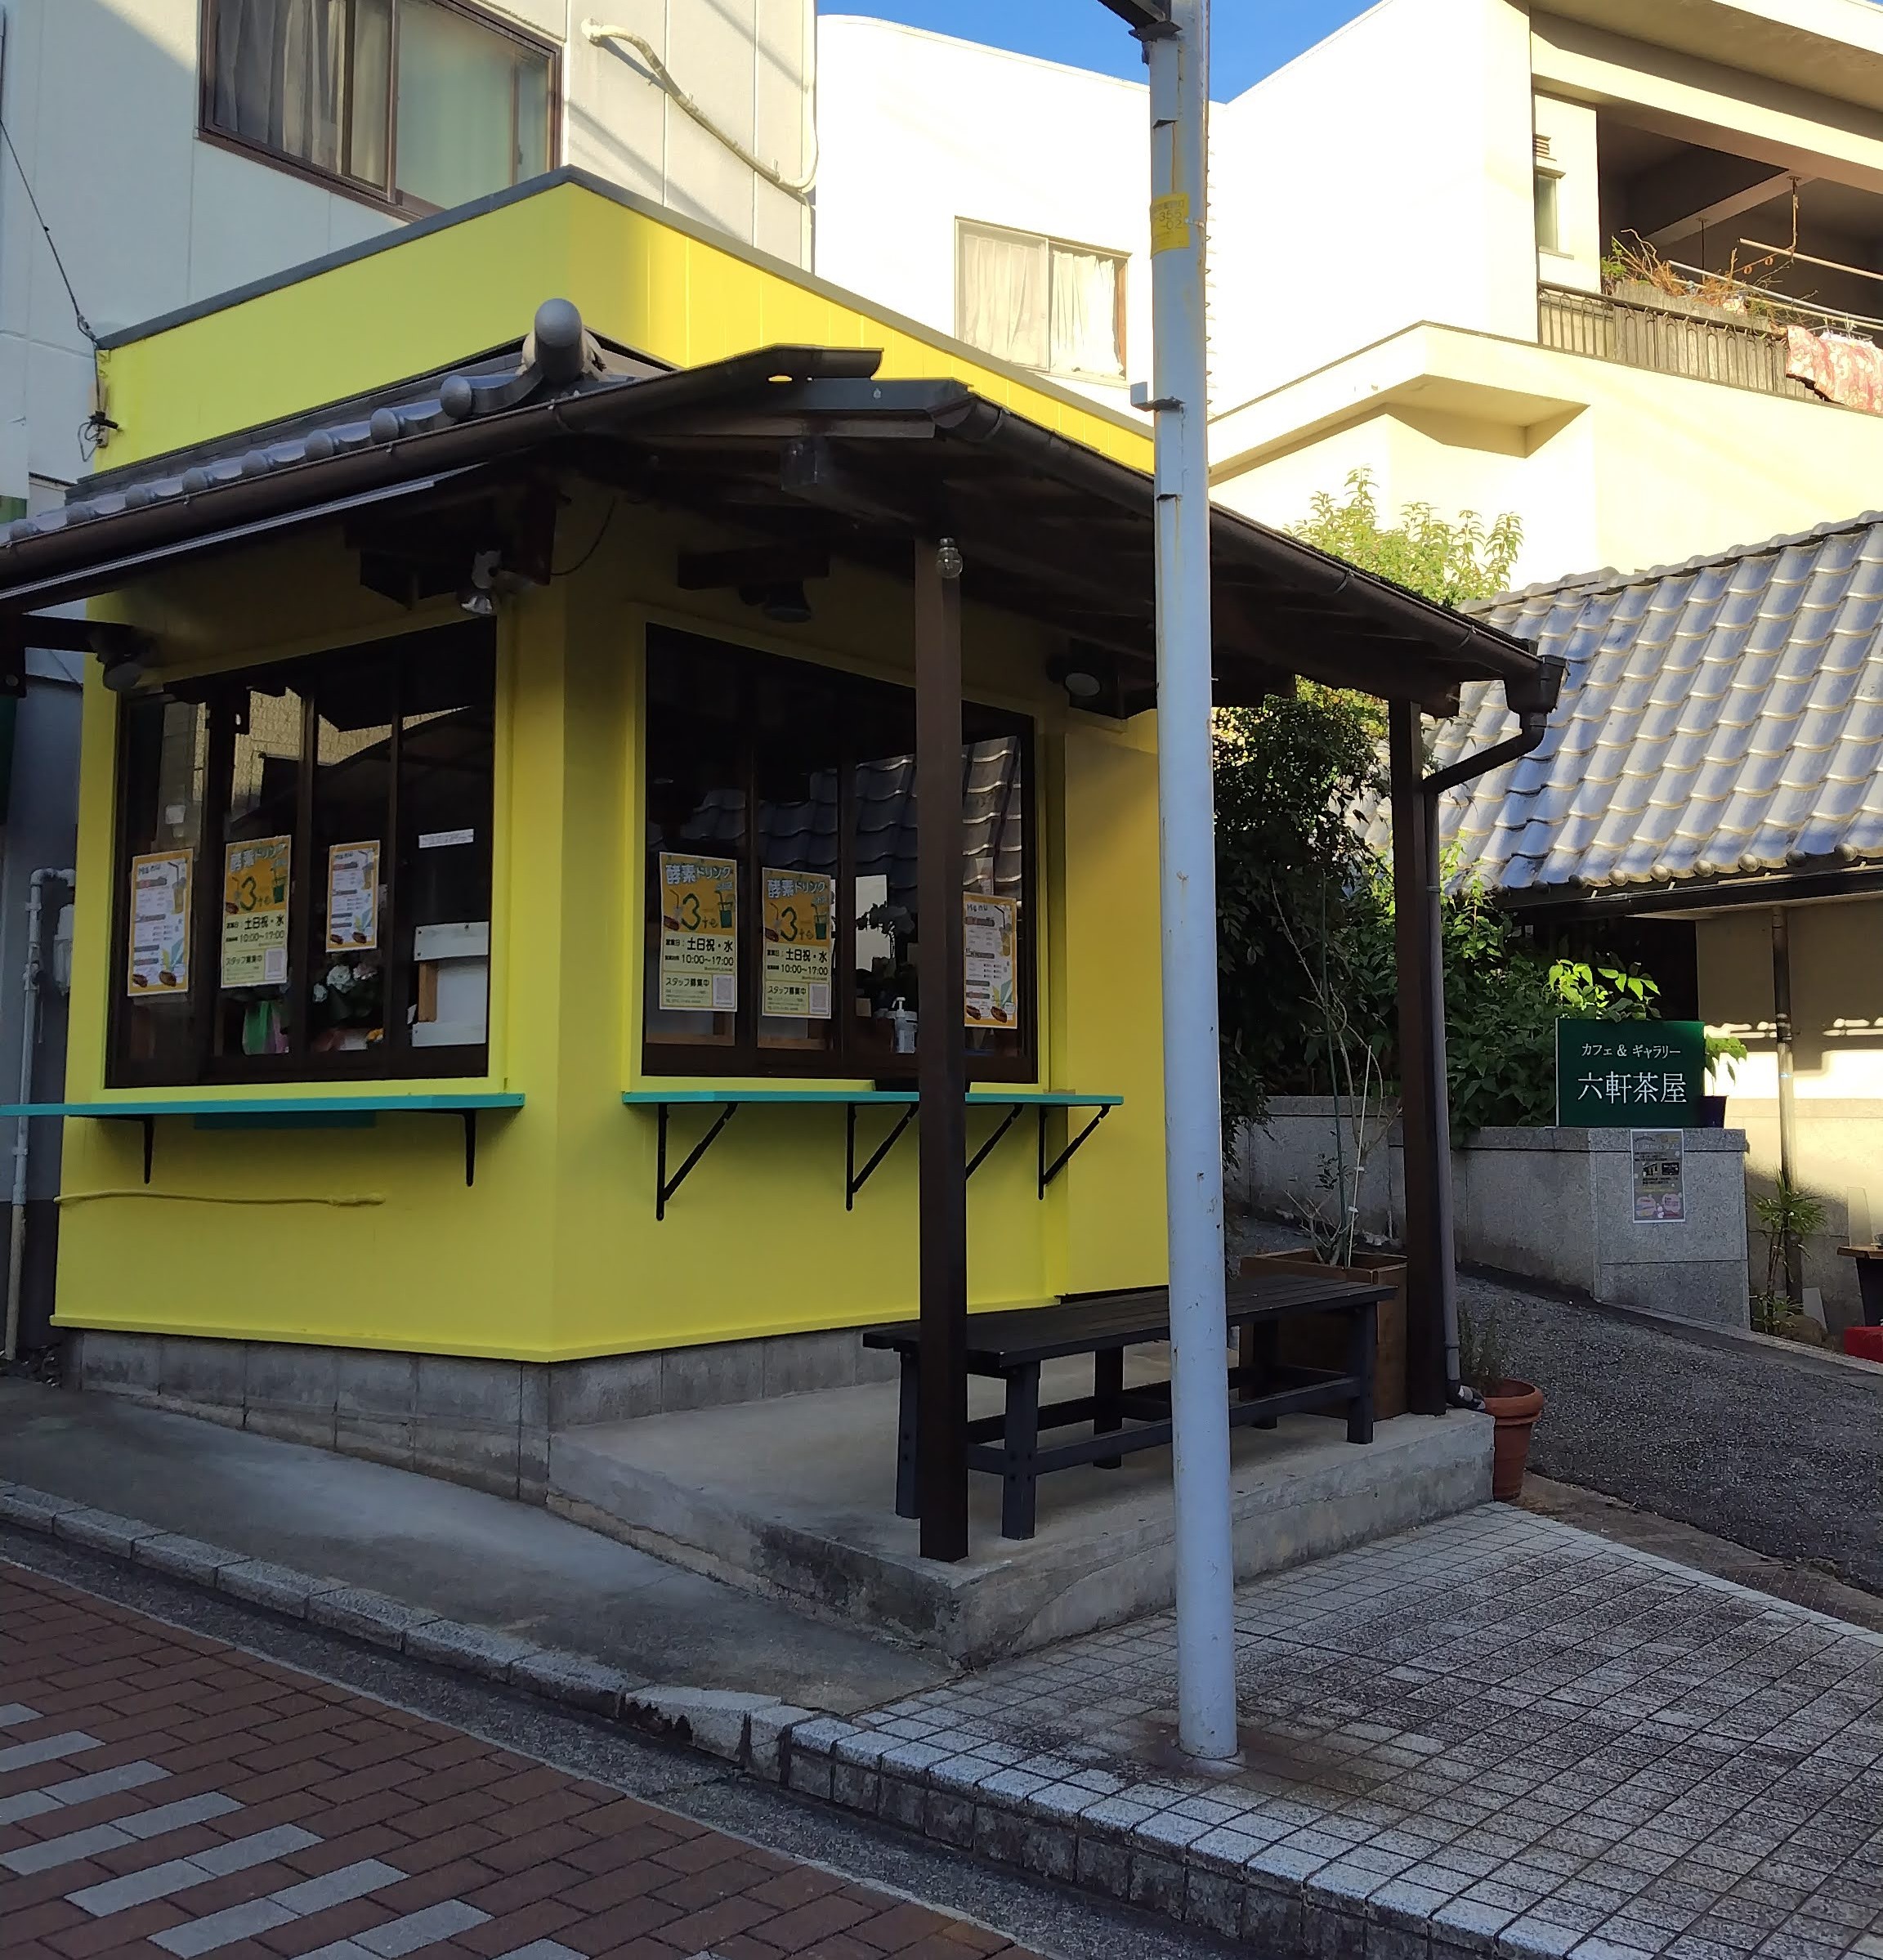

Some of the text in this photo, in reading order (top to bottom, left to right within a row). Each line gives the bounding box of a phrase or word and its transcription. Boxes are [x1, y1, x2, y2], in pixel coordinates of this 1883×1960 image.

[687, 937, 733, 952] 土日祝・水
[785, 948, 827, 963] 土日祝・水
[1581, 1044, 1681, 1058] カフェ & ギャラリー
[1577, 1071, 1687, 1103] 六軒茶屋
